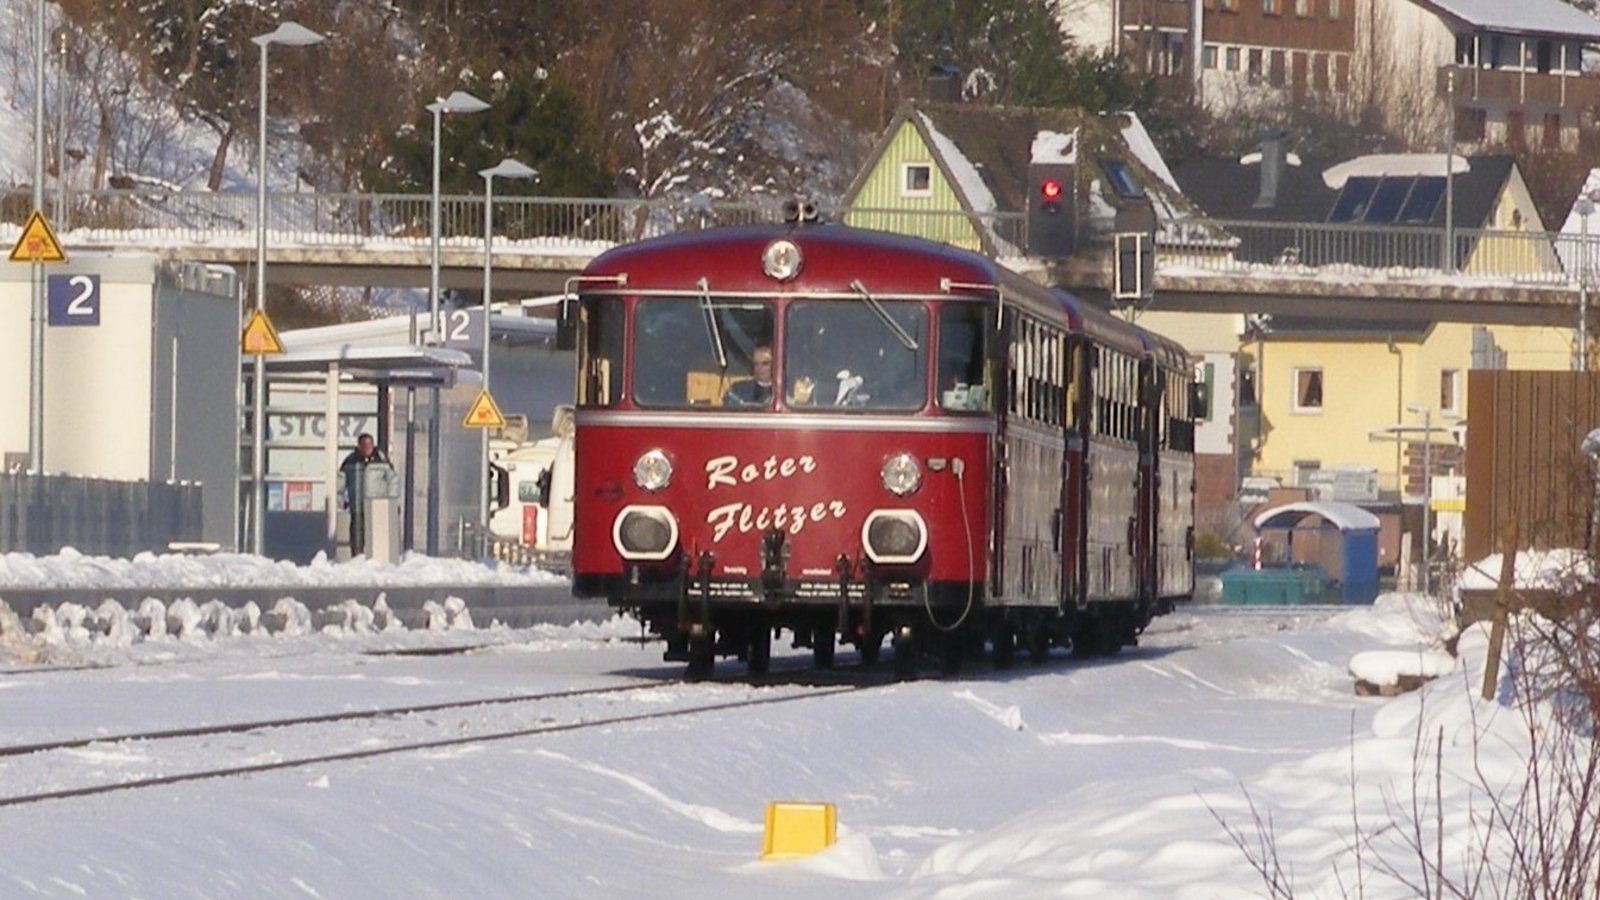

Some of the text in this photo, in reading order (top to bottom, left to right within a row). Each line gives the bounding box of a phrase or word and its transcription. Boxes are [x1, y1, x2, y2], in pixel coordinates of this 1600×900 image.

[67, 275, 94, 315] 2
[705, 454, 817, 490] Roter
[707, 500, 847, 543] Flitzer
